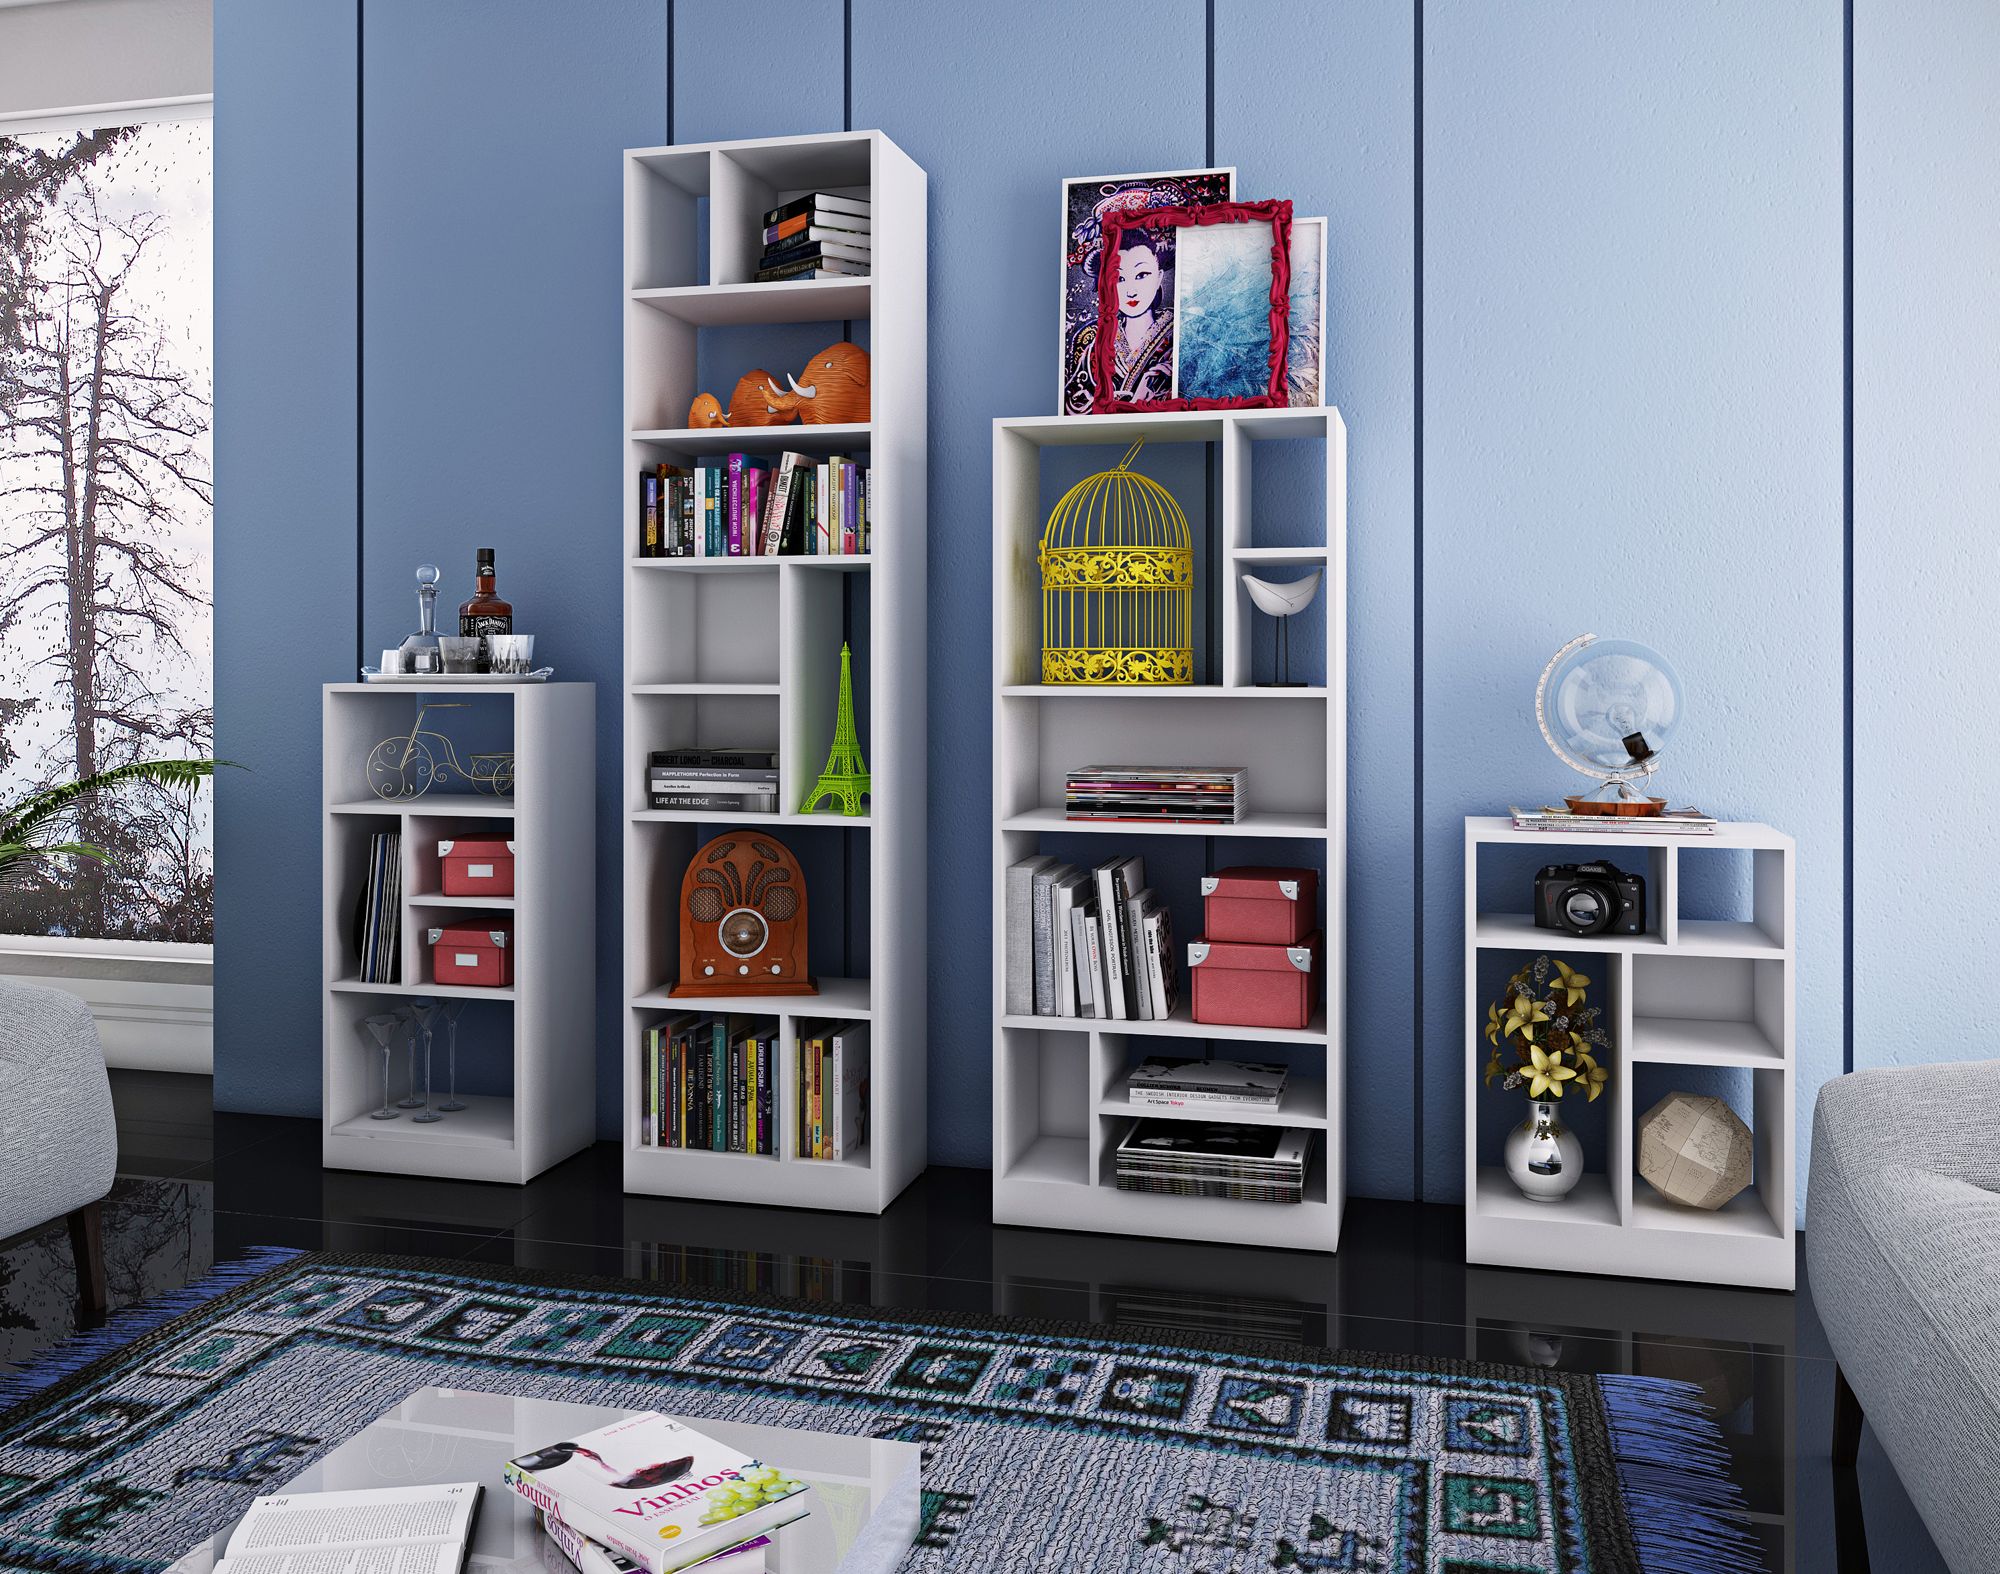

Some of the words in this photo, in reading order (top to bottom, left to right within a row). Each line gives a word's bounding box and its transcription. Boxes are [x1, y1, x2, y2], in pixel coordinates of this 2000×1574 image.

[478, 620, 489, 628] JACK
[712, 756, 744, 766] CHARCOAL
[516, 1480, 564, 1521] Vinhos
[612, 1466, 740, 1518] Vinhos
[547, 1516, 584, 1574] Vinhos
[606, 1535, 624, 1550] Santos
